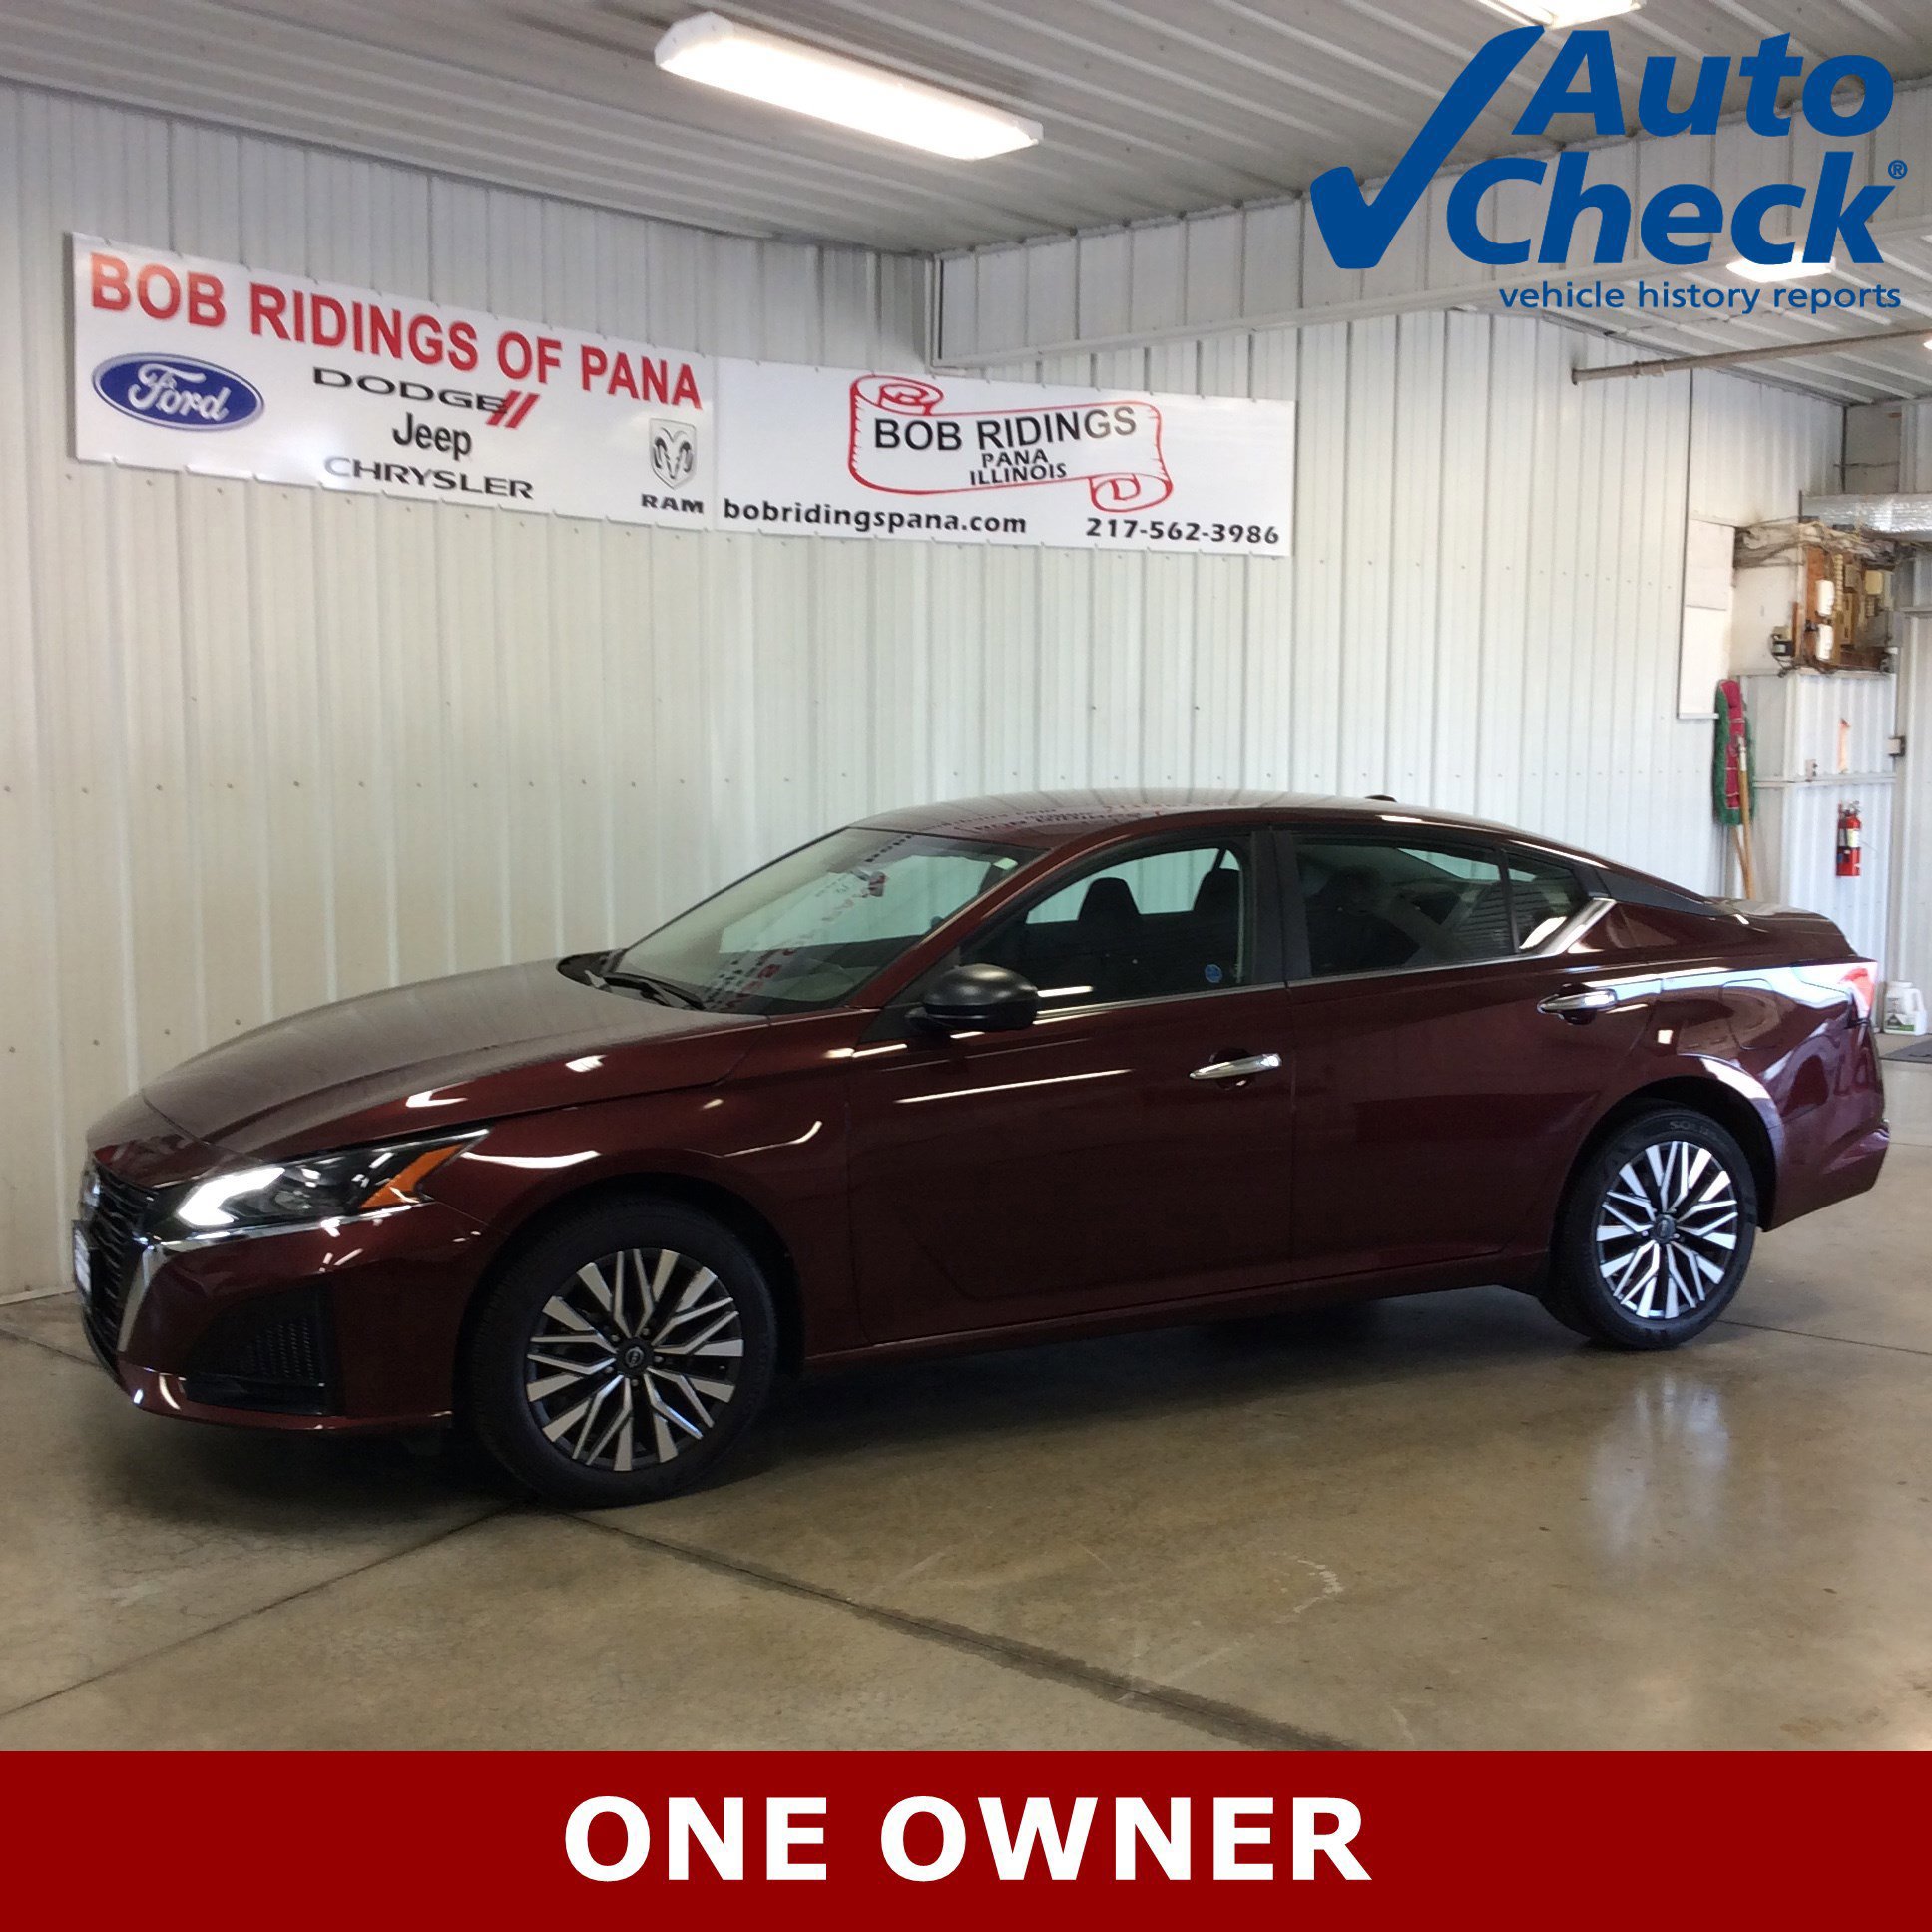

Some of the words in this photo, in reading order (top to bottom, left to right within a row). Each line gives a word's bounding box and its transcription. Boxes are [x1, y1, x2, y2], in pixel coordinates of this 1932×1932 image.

[90, 251, 228, 329] BOB
[248, 281, 480, 372] RIDINGS
[496, 330, 563, 385] OF
[580, 344, 703, 411] PANA
[127, 362, 232, 422] Ford
[312, 366, 506, 414] DODGE
[391, 411, 472, 462] Jeep
[873, 418, 963, 452] BOB
[976, 405, 1137, 451] RIDINGS
[323, 455, 534, 501] CHRYSLER
[969, 462, 1067, 486] ILLINOIS
[980, 448, 1049, 469] PANA
[641, 493, 705, 515] RAM
[723, 498, 1027, 535] bobridingspana.com
[1086, 516, 1279, 545] 217-562-3986
